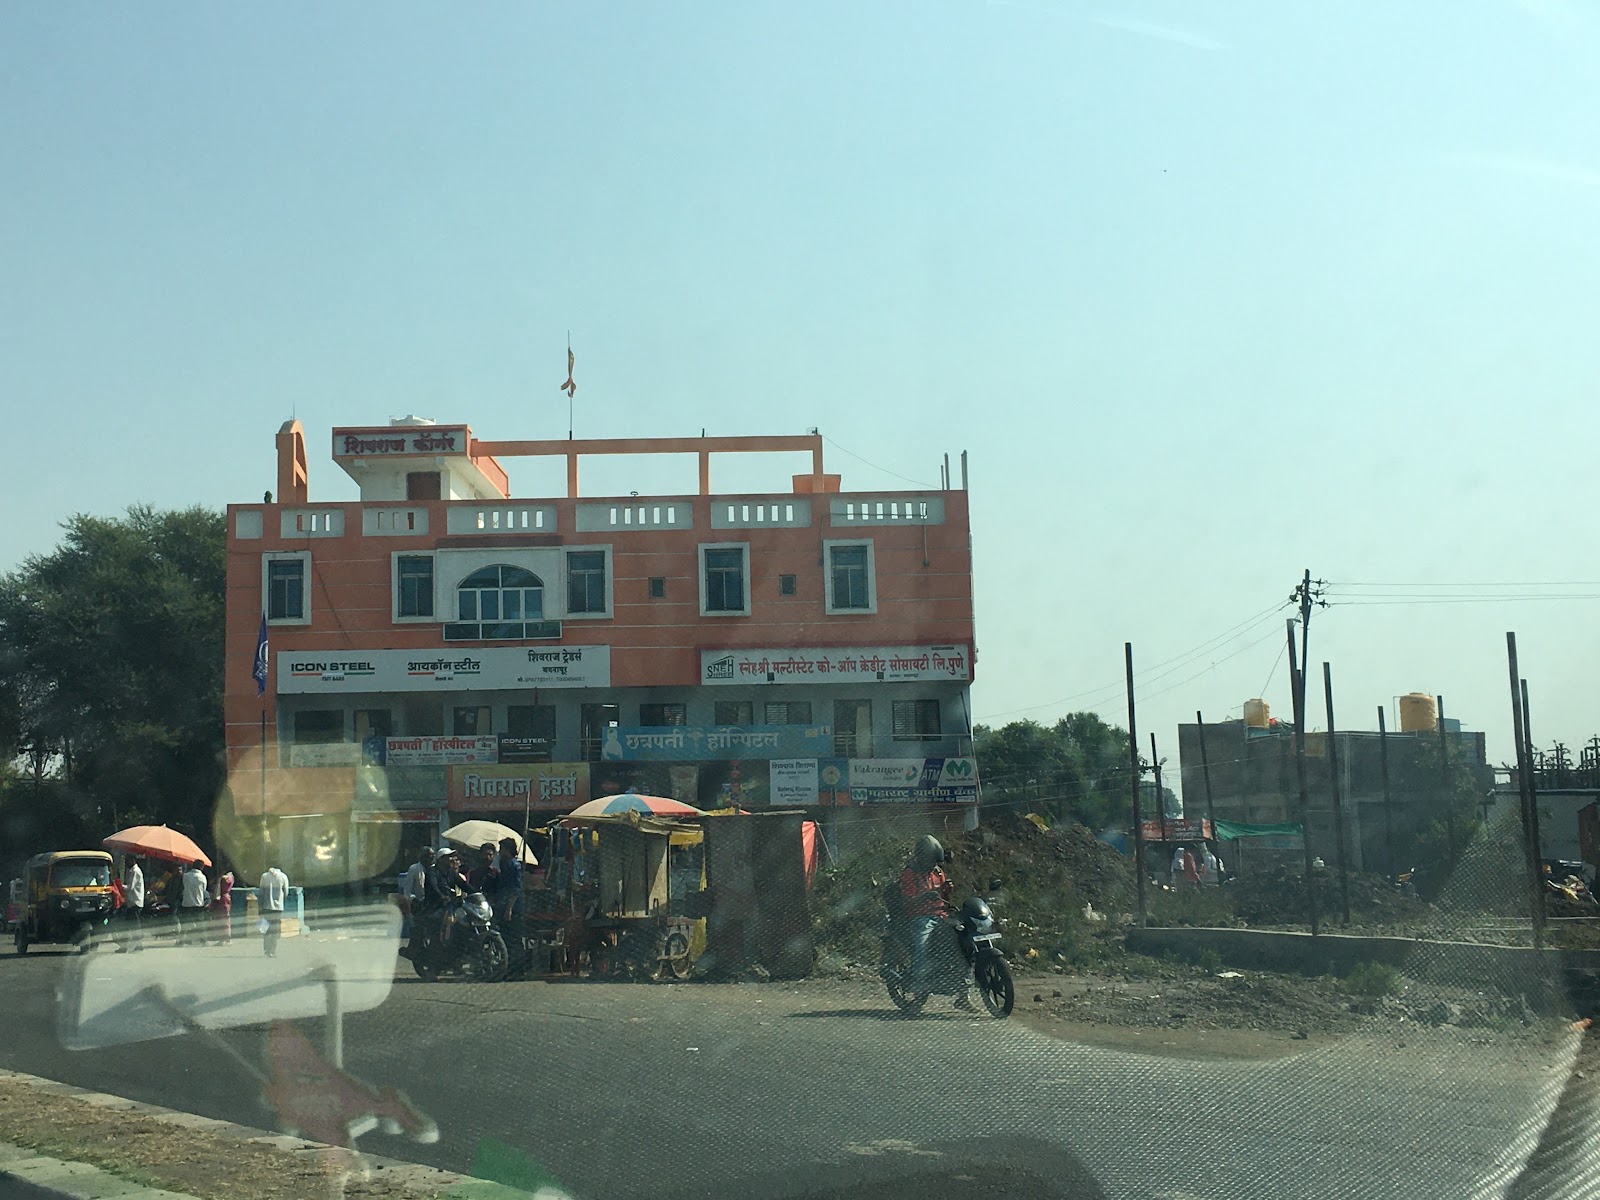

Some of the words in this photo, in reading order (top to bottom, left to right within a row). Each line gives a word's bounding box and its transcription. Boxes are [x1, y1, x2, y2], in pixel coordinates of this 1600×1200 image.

[344, 435, 406, 454] शिवराज
[527, 649, 561, 662] शिवराज
[562, 649, 582, 663] ट्रेडर्स
[291, 663, 327, 672] ICON
[329, 662, 375, 671] STEEL
[407, 659, 452, 671] आयकॉन
[453, 657, 481, 670] स्टील
[772, 655, 815, 674] मल्टीस्टेट
[889, 653, 929, 672] सोसायटी
[388, 738, 422, 751] छत्रपती
[625, 728, 685, 750] छत्रपती
[854, 764, 904, 776] Vakrangee
[921, 768, 941, 781] ATM
[464, 773, 532, 798] शिवराज
[538, 771, 577, 800] ट्रेडर्स
